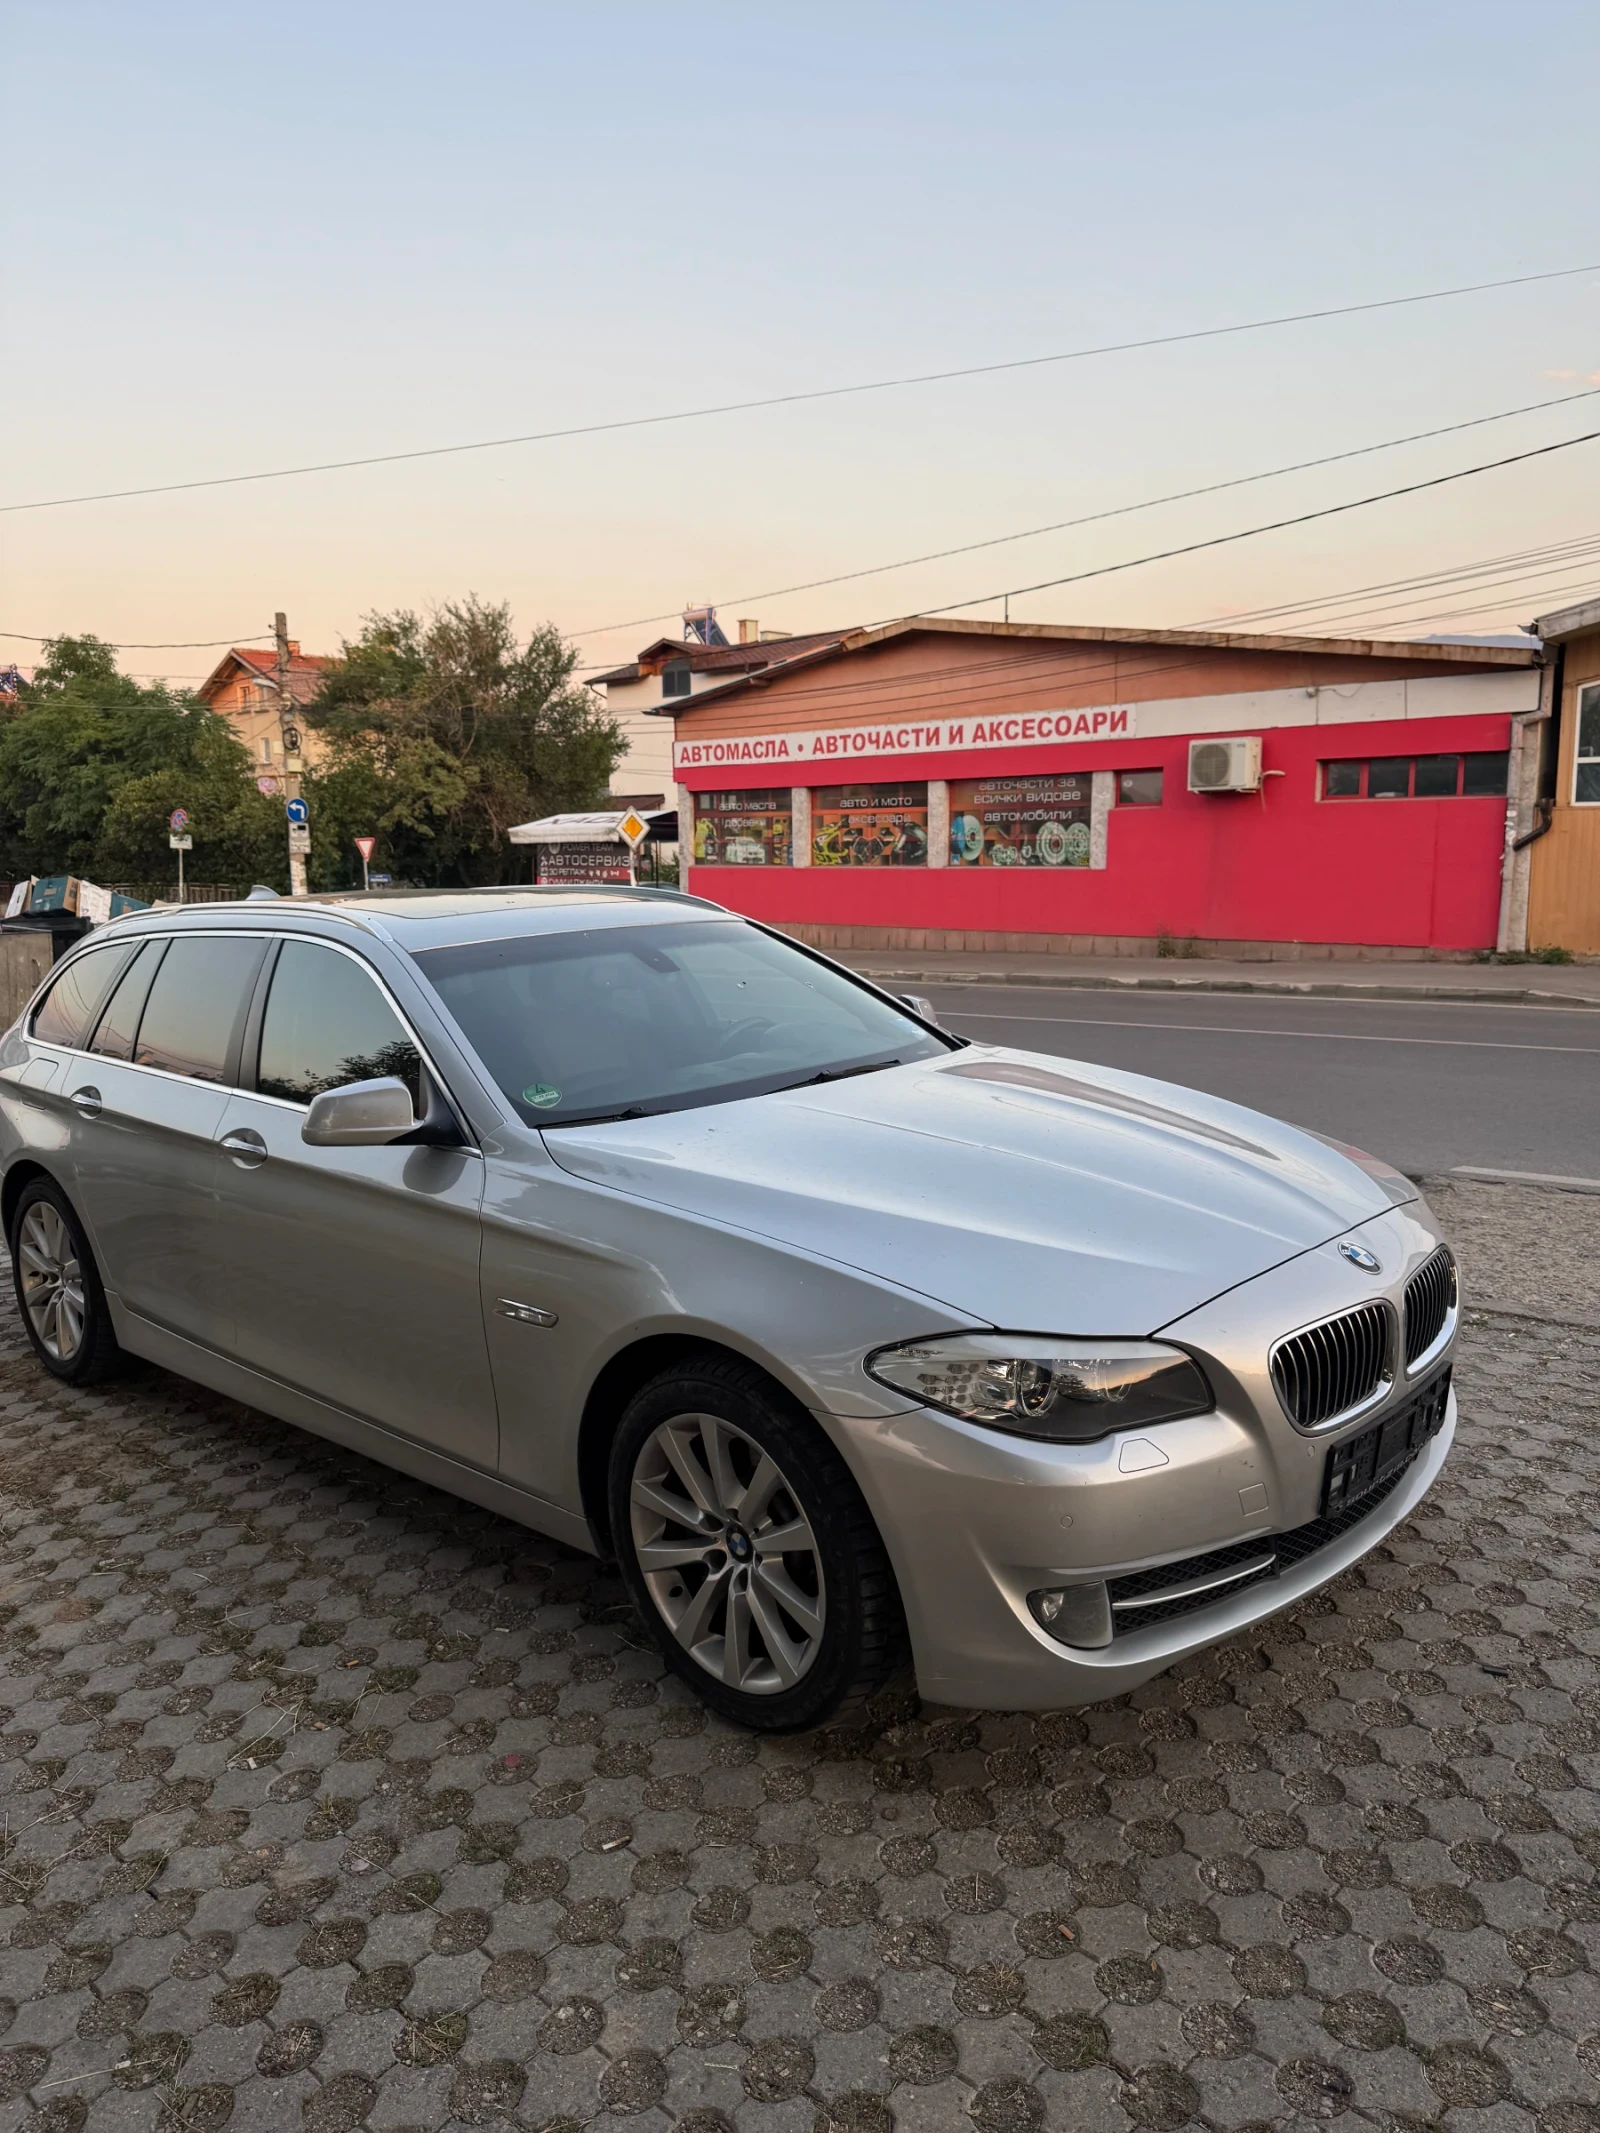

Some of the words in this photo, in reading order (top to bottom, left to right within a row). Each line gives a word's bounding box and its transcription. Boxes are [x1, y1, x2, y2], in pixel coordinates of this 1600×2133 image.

[680, 739, 789, 764] АВТОМАСЛА
[812, 726, 940, 755] АВТОЧАСТИ
[948, 725, 963, 744] И
[972, 710, 1129, 743] АКСЕСОАРИ
[1057, 777, 1076, 788] за
[840, 798, 868, 808] авто
[881, 797, 913, 806] мото
[1026, 791, 1082, 804] видове
[984, 809, 1073, 822] автомобили
[548, 854, 631, 867] АВТОСЕРВИЗ
